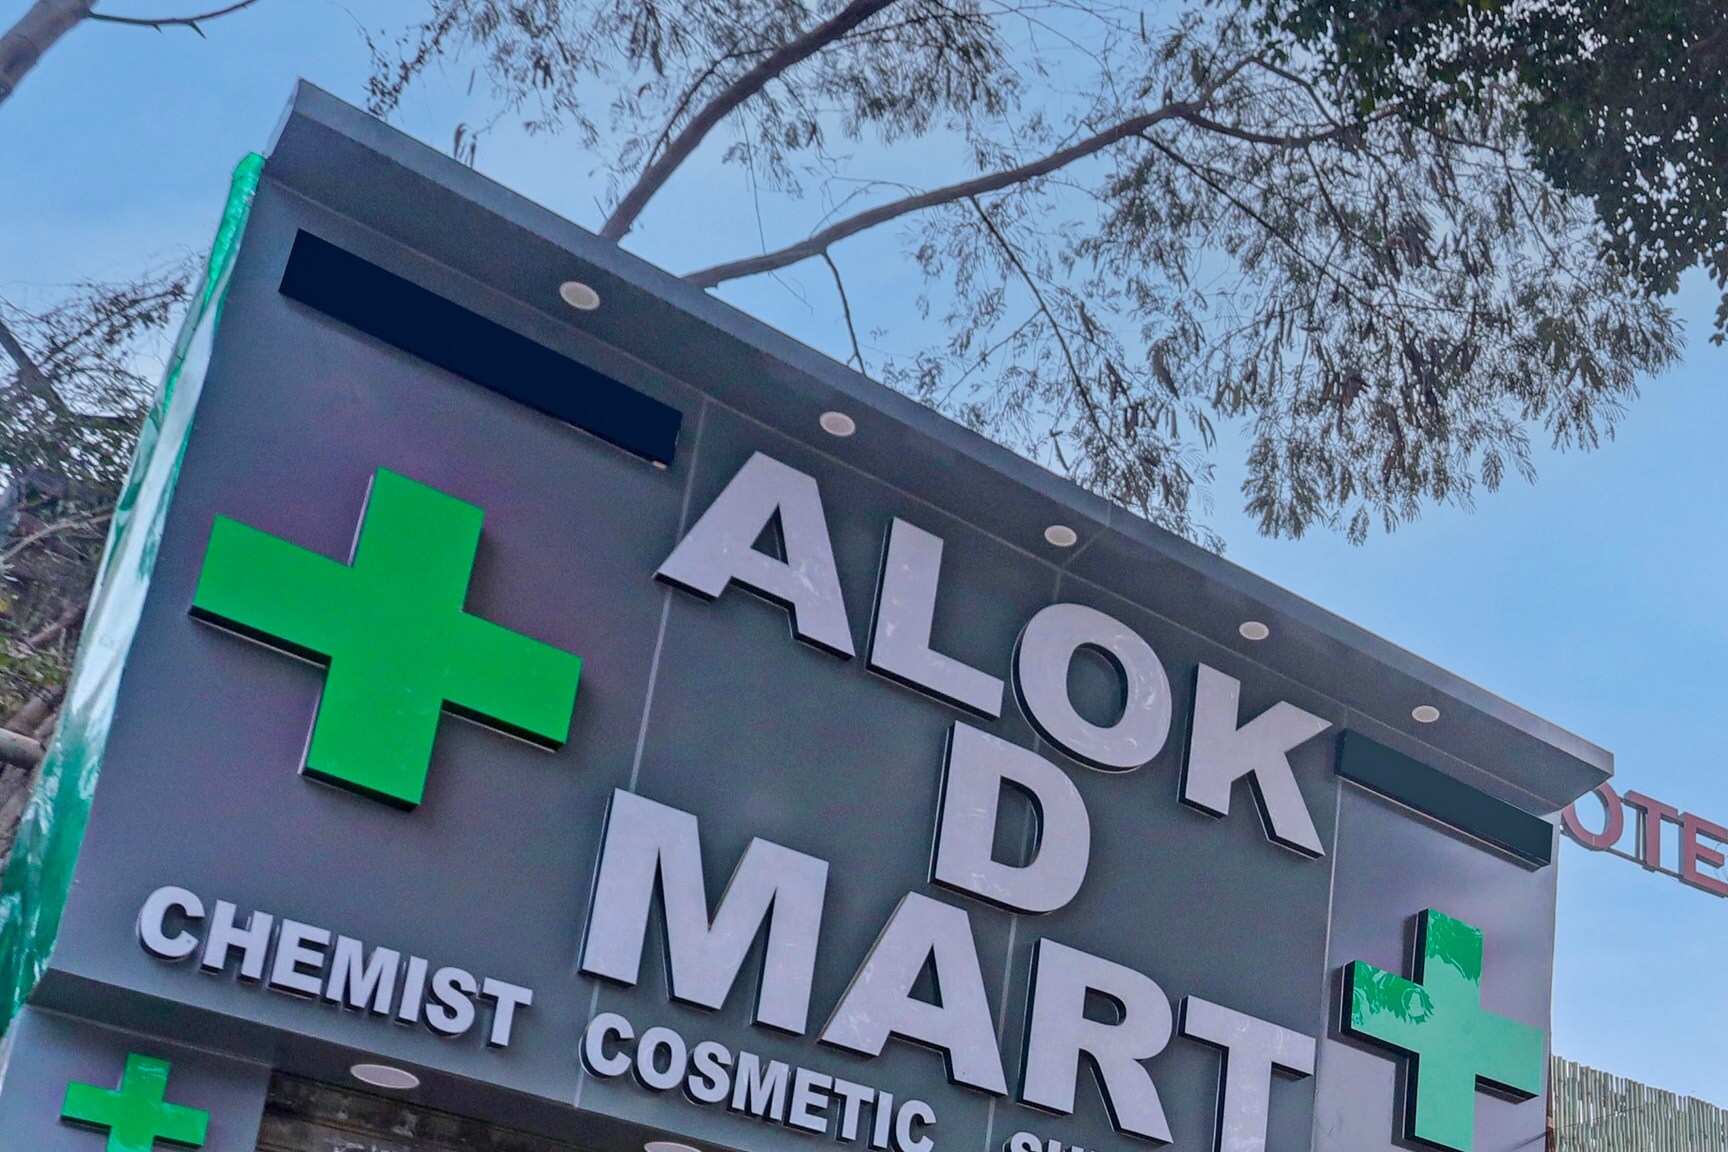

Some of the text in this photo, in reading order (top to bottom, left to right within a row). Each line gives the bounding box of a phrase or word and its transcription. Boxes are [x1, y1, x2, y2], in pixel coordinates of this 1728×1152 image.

[654, 451, 1333, 859] ALOK
[928, 720, 1092, 915] D
[135, 885, 533, 1048] CHEMIST
